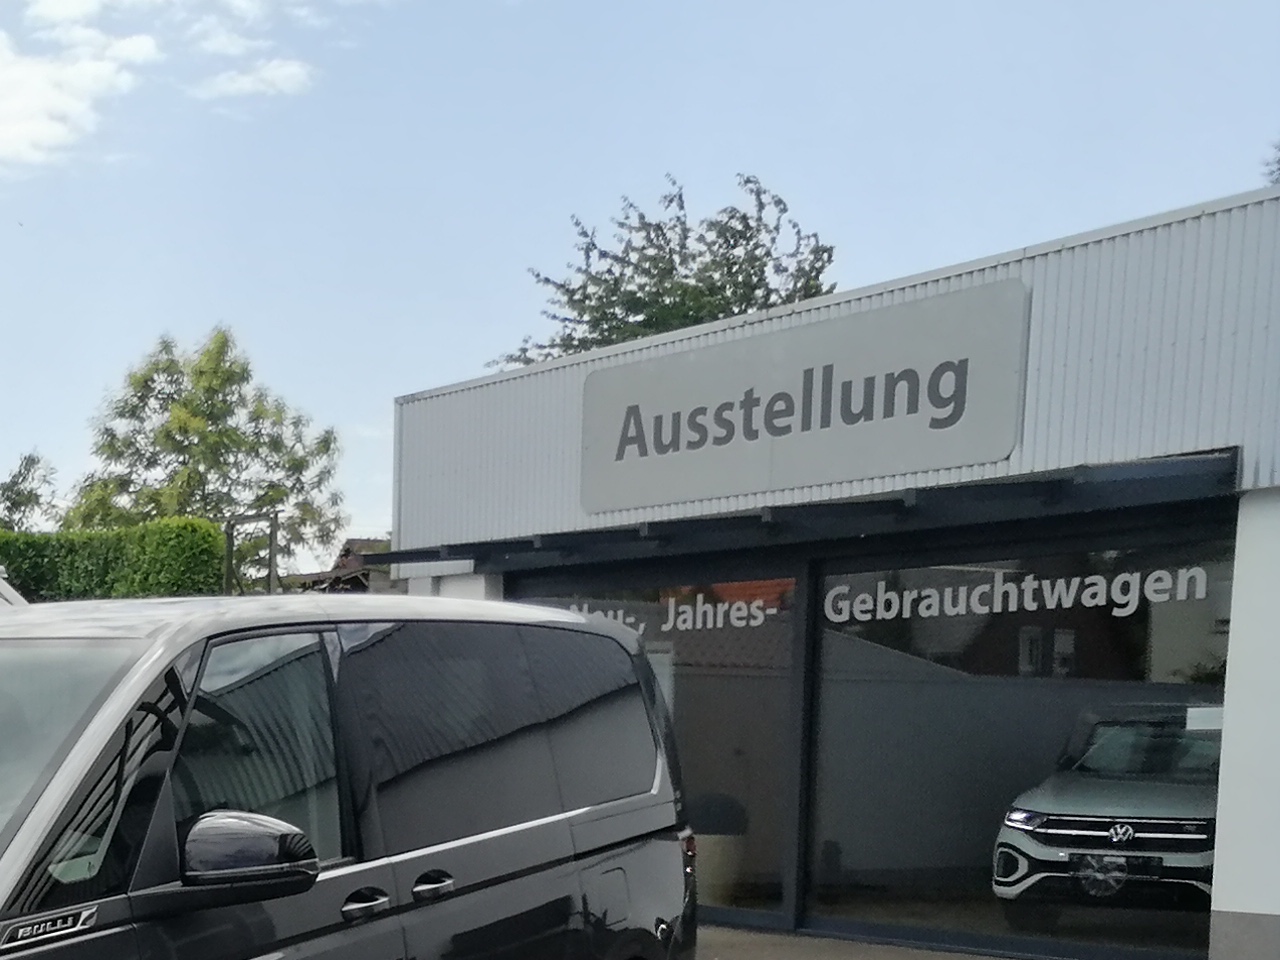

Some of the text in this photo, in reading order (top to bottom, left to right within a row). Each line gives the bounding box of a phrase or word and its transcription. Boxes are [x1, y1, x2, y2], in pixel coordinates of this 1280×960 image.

[615, 358, 969, 461] Ausstellung
[661, 593, 777, 632] Jahres-
[823, 566, 1208, 624] Gebrauchtwagen
[18, 917, 73, 939] BULLI
